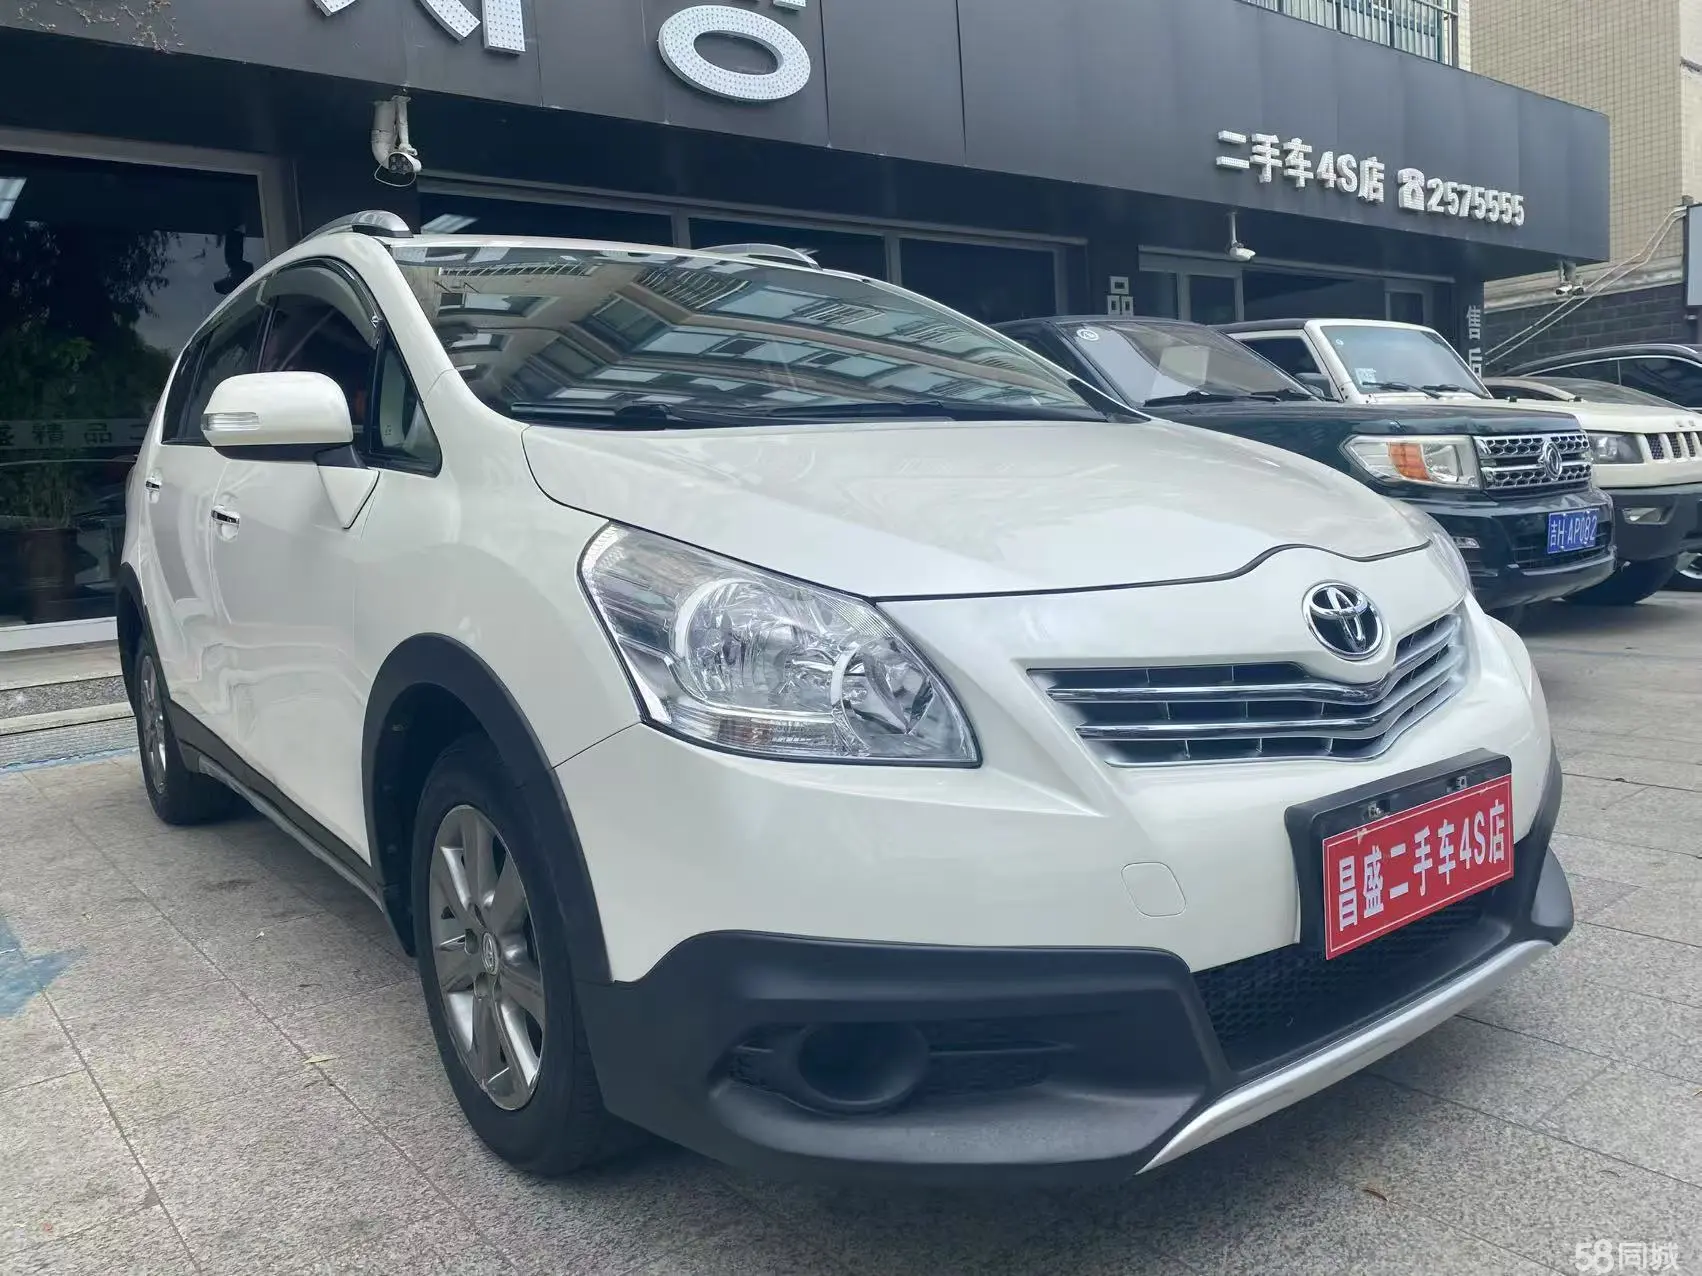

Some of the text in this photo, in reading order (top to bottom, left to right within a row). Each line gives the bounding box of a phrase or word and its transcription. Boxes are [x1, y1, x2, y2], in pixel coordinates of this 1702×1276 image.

[1215, 130, 1525, 227] 二手车4S店 2575555
[1338, 799, 1505, 932] 昌盛二手车4S店
